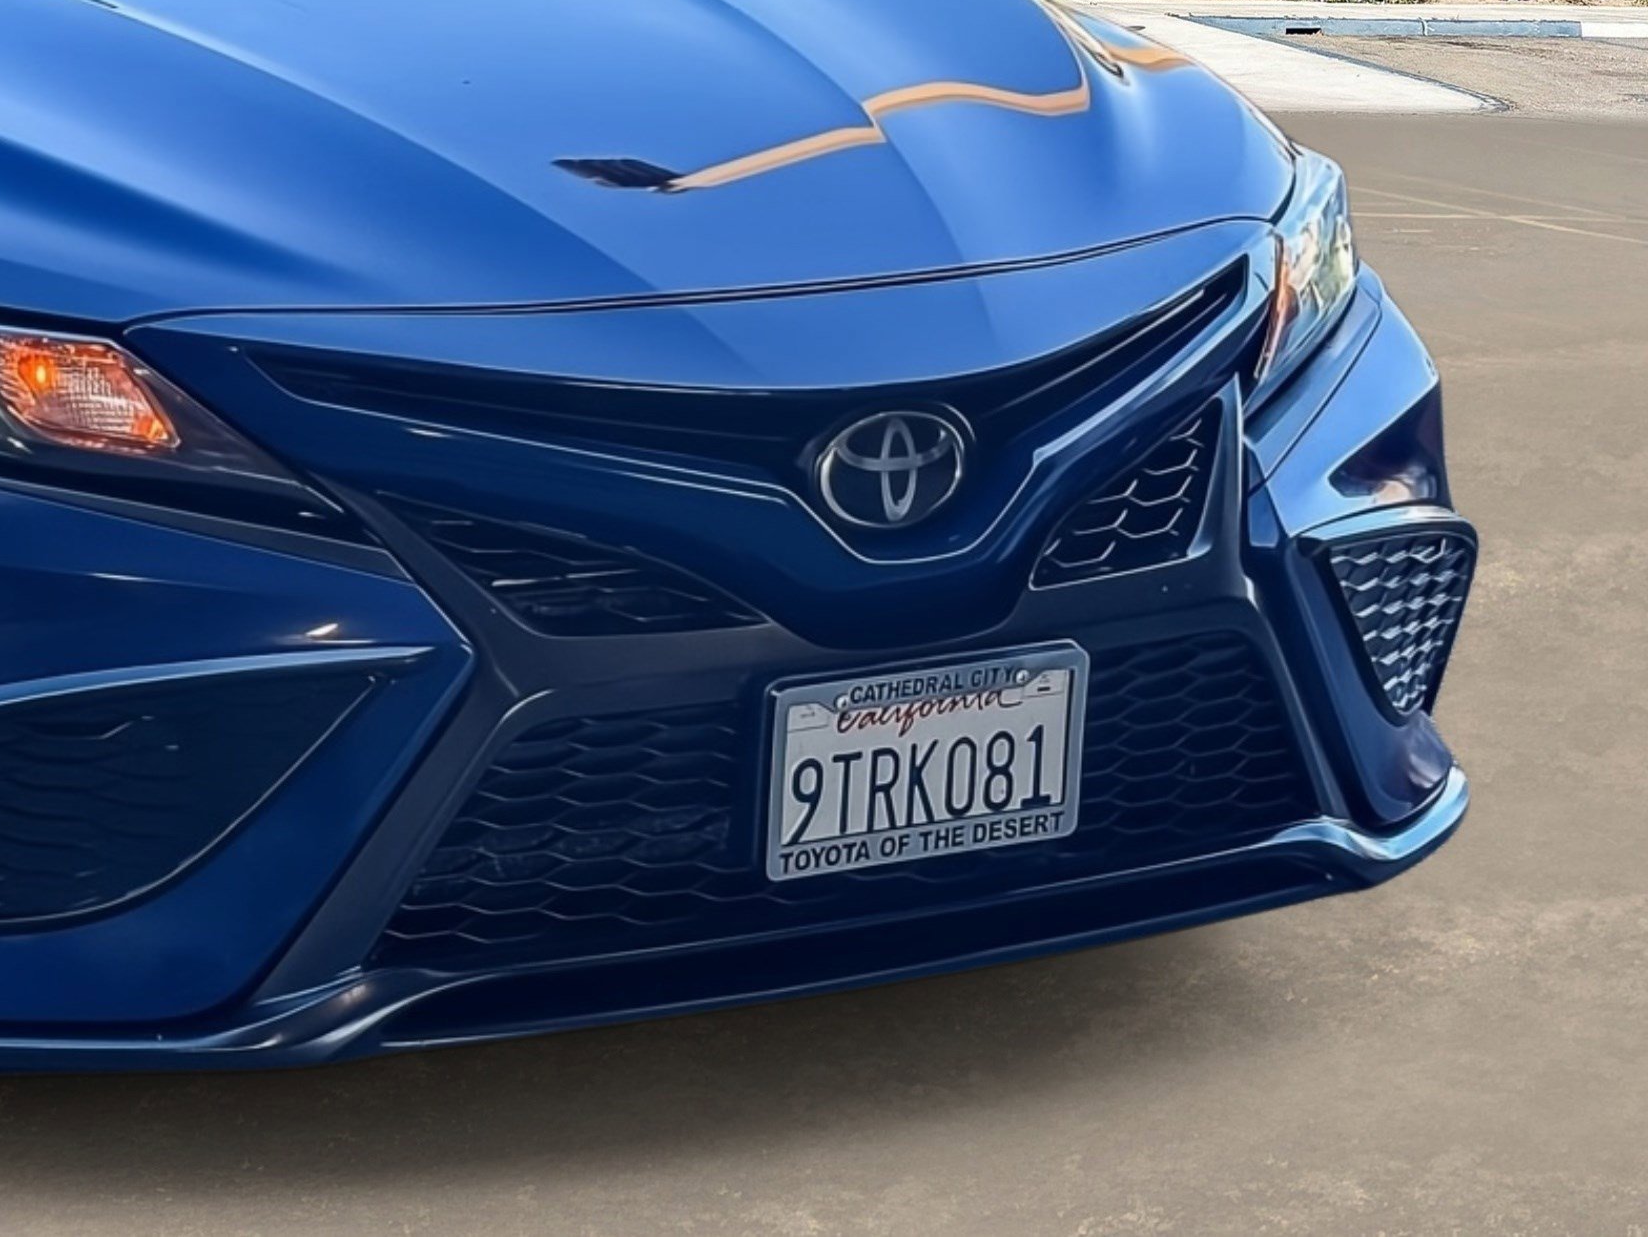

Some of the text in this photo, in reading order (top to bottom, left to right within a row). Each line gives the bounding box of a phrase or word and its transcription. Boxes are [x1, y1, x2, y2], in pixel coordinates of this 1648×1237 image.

[850, 665, 1015, 704] CATHEDRAL CITY
[782, 724, 1051, 846] 9TRK081
[779, 811, 1065, 874] TOYOTA OF THE DESERT
